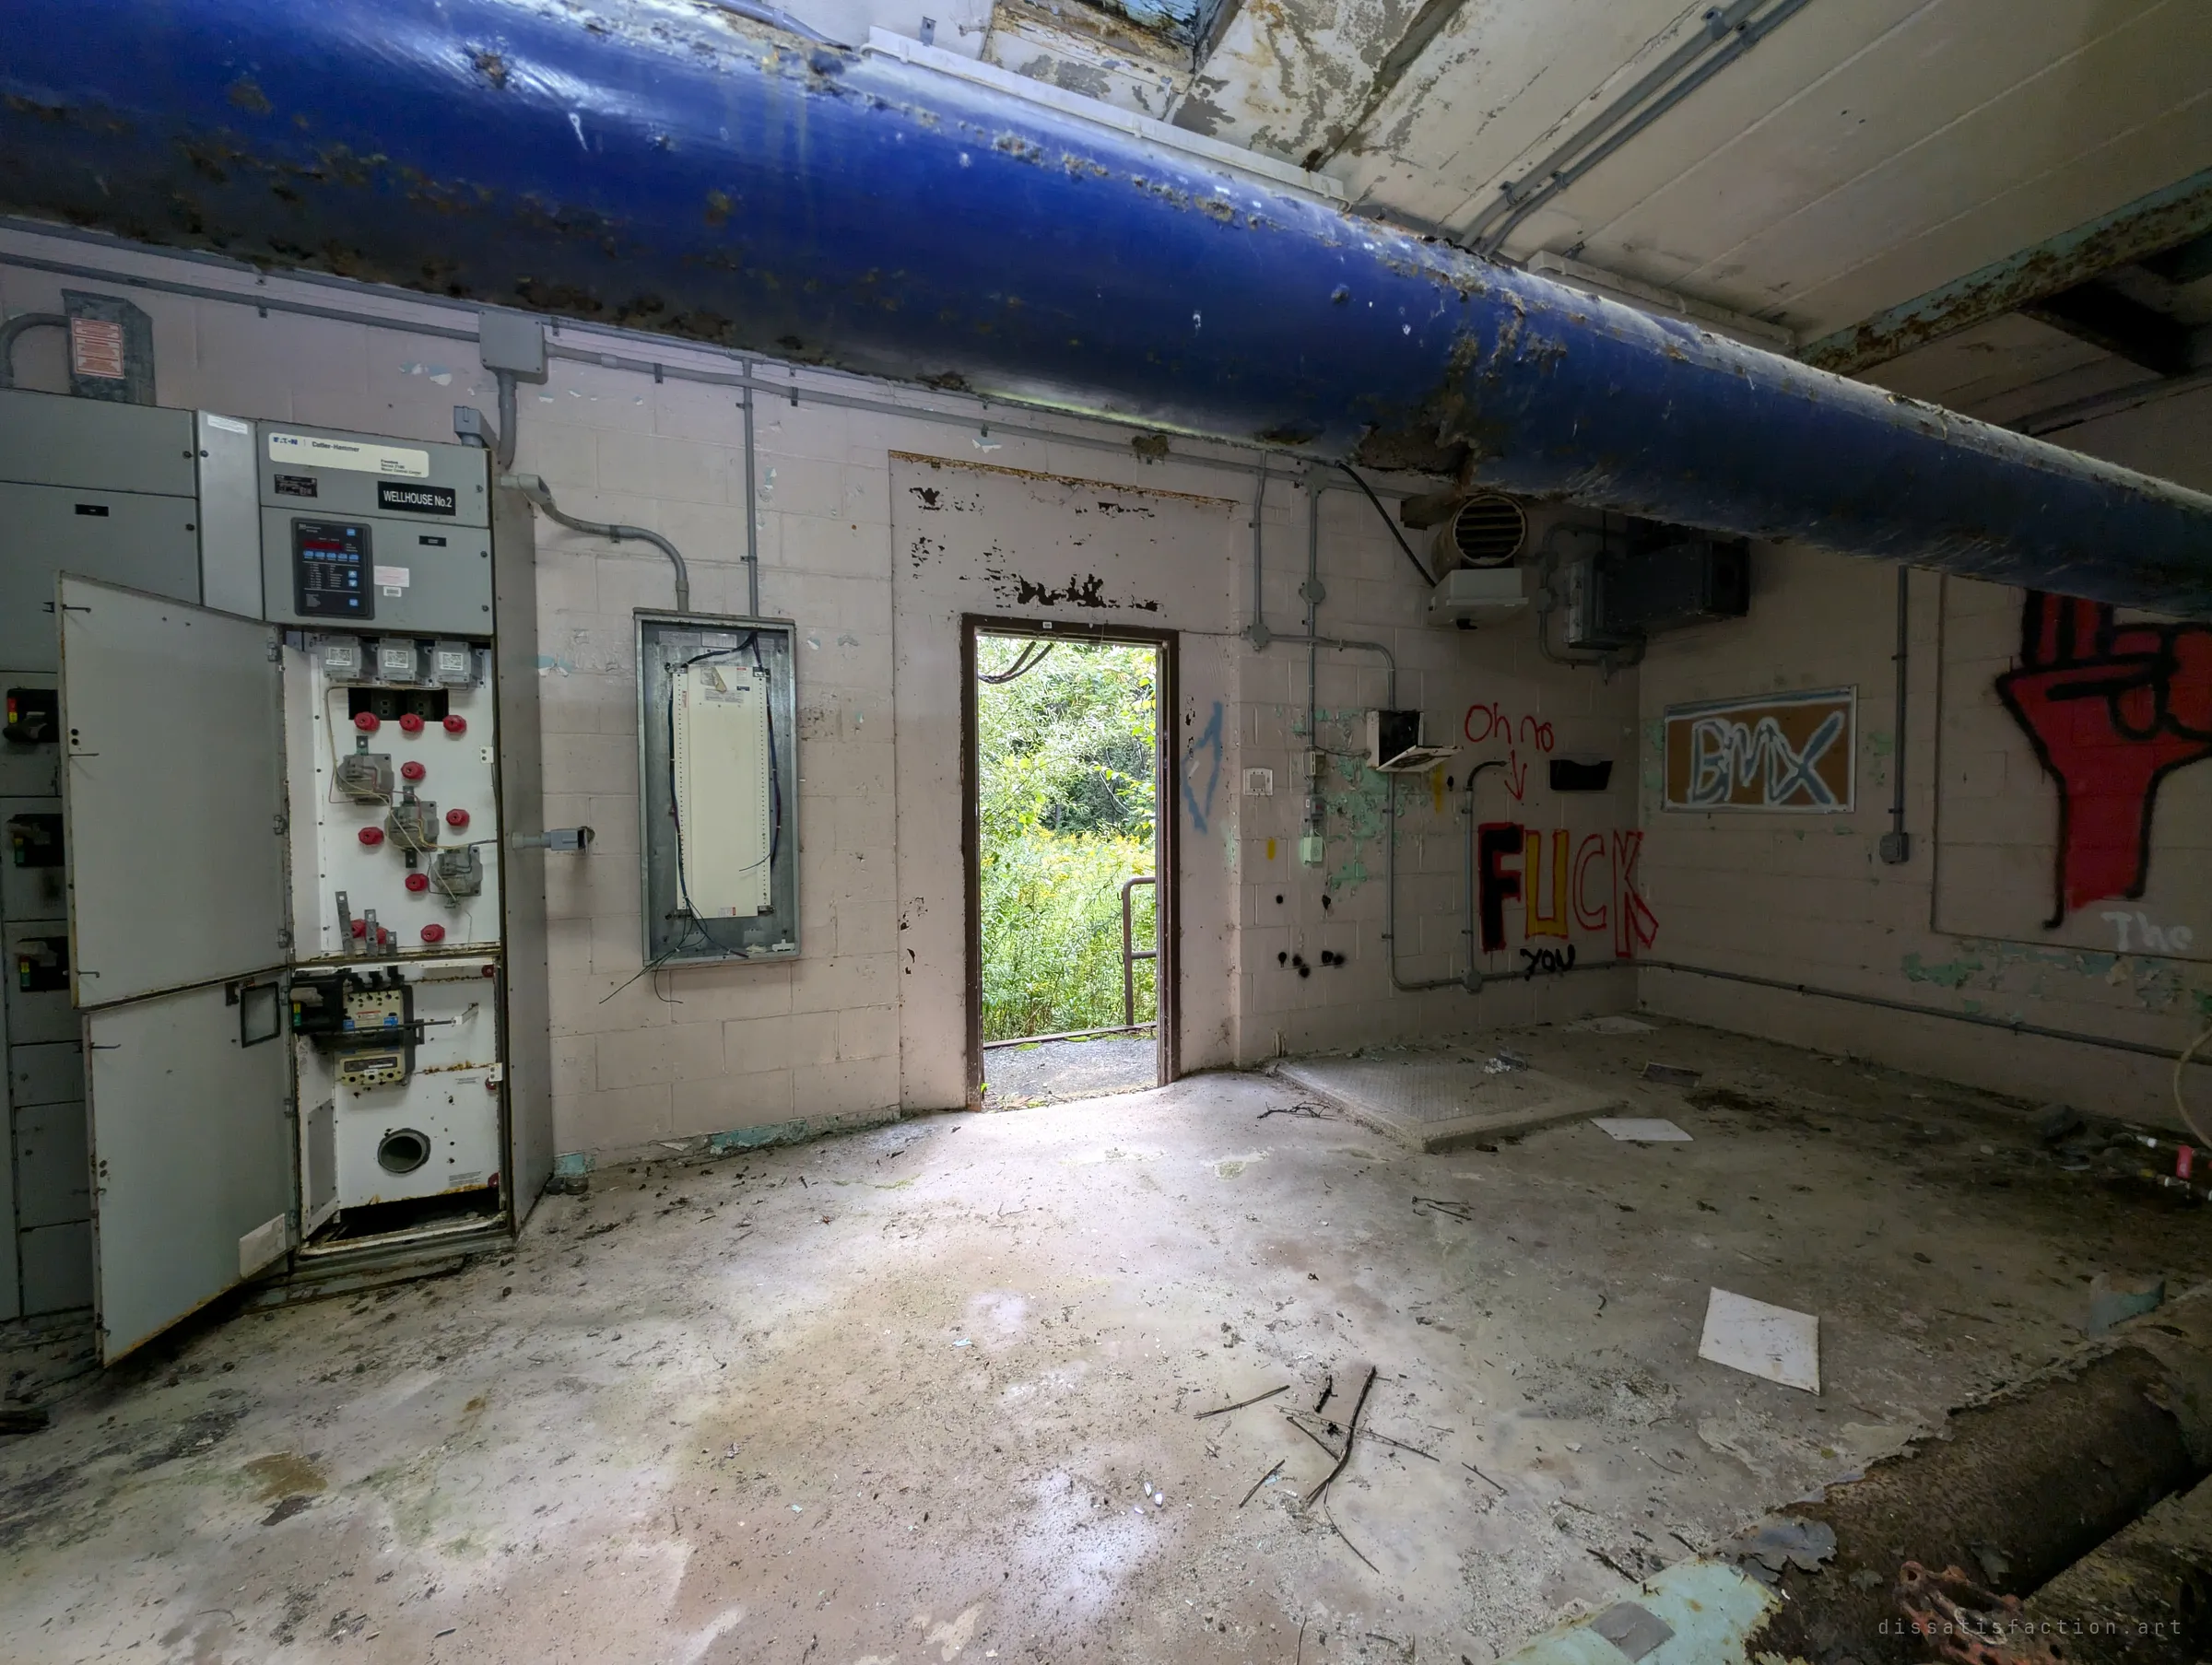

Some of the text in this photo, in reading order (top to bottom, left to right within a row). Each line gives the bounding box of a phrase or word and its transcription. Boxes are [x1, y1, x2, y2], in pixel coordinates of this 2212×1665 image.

[382, 490, 453, 508] WELLHOUSE No.2
[1465, 702, 1555, 753] Oh no
[1688, 710, 1843, 806] BMX
[1478, 822, 1658, 957] FUCK
[2102, 911, 2193, 952] The
